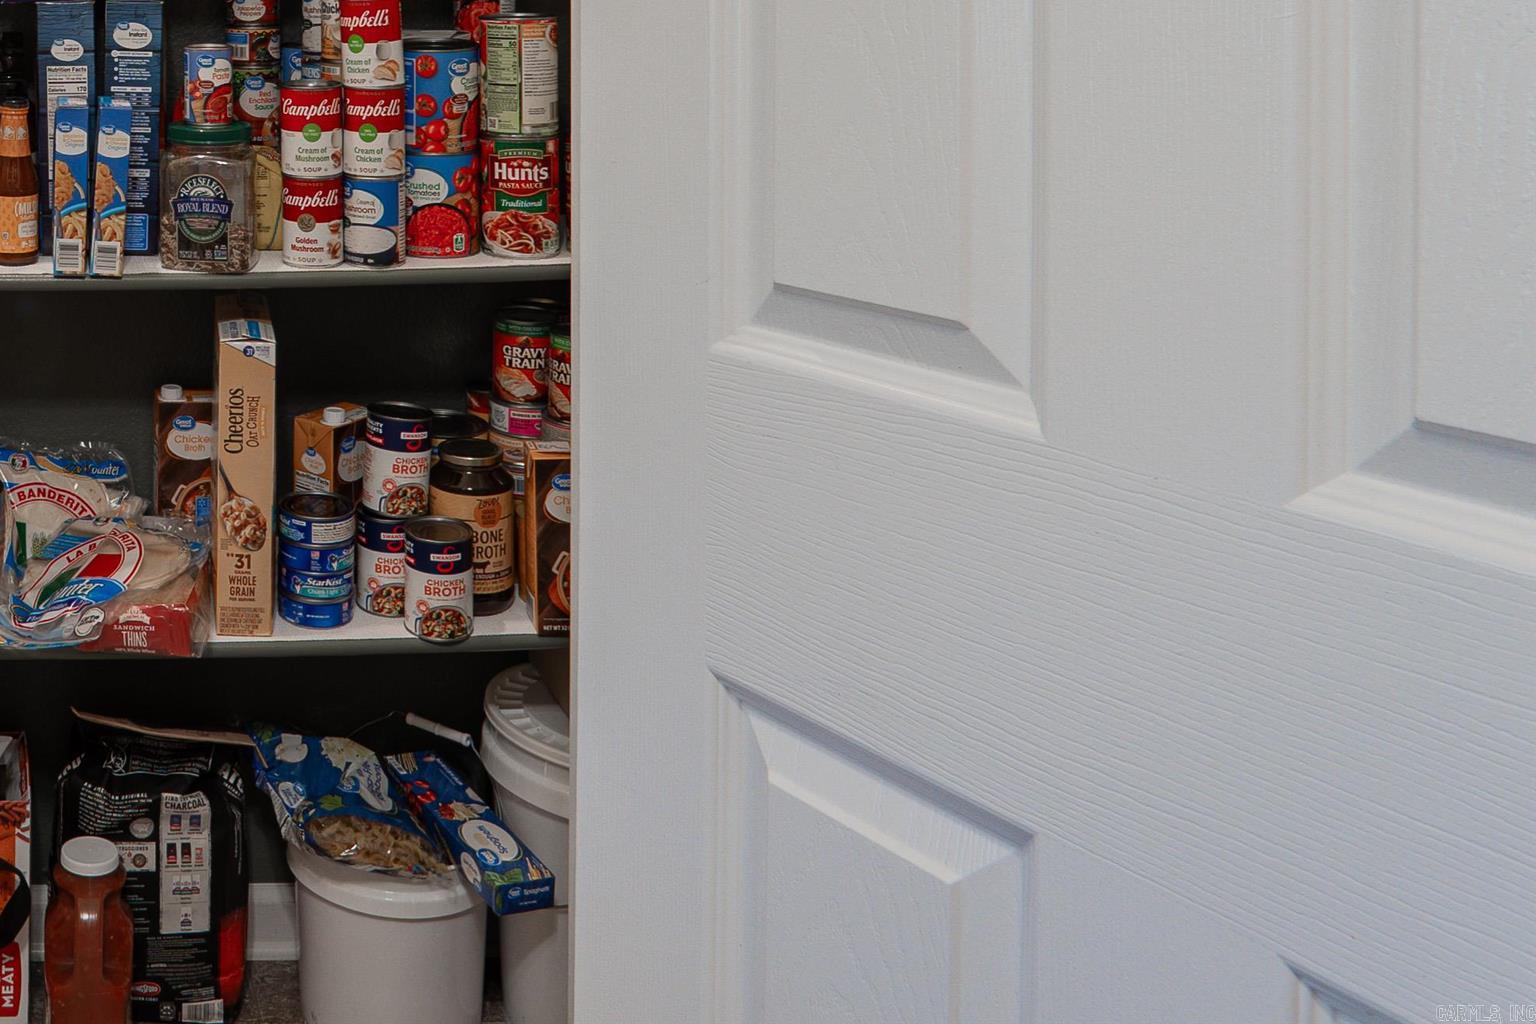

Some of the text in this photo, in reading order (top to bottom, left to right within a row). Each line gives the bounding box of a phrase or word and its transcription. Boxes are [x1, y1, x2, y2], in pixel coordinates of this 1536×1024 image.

[347, 66, 370, 74] Chicken
[254, 103, 274, 111] Sauce
[282, 97, 341, 121] Campbell's
[297, 146, 328, 154] Cream of
[354, 146, 384, 154] Cream of
[295, 154, 330, 163] Mushroom
[355, 154, 382, 163] Chicken
[493, 161, 549, 183] Hunt's
[179, 176, 224, 196] RICESELECT
[176, 202, 230, 215] ROYAL BLEND
[500, 198, 543, 208] Traditional
[295, 236, 318, 245] Golden
[290, 243, 325, 253] Mushroom
[502, 344, 547, 358] GRAVY
[503, 355, 545, 369] TRAIN
[224, 387, 244, 455] Cheerios
[246, 395, 261, 448] OAT CRUNCH
[174, 434, 212, 444] Chicke
[184, 442, 207, 453] Broth
[395, 457, 428, 465] CHICKEN
[392, 463, 429, 475] BROTH
[471, 528, 505, 544] BONE
[66, 549, 85, 564] LA
[233, 553, 252, 570] 31
[431, 553, 462, 561] SWANSON
[228, 575, 257, 586] WHOLE
[305, 577, 343, 586] StarKist
[426, 579, 465, 587] CHICKEN
[229, 586, 256, 597] GRAIN
[424, 585, 466, 597] BROTH
[113, 623, 156, 632] SANDWICH
[121, 630, 148, 649] THINS
[164, 798, 207, 811] CHARCOAL
[476, 823, 508, 855] Spaghetti
[0, 953, 15, 1008] MEATY
